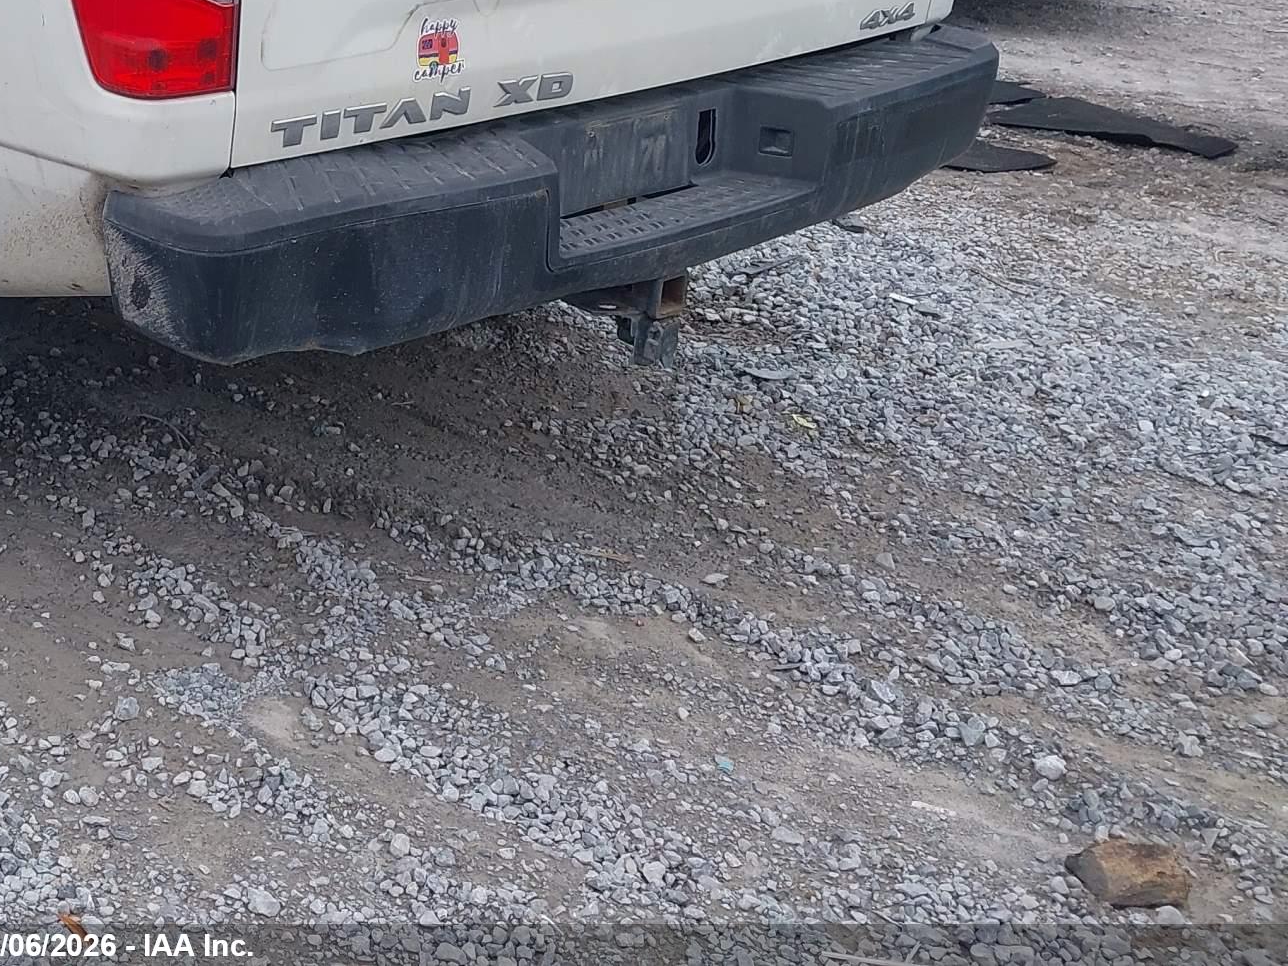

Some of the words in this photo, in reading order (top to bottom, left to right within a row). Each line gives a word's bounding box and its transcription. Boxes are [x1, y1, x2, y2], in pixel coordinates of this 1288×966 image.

[420, 17, 459, 38] happy
[414, 60, 465, 83] camper
[270, 86, 472, 148] TITAN
[492, 71, 574, 108] XD
